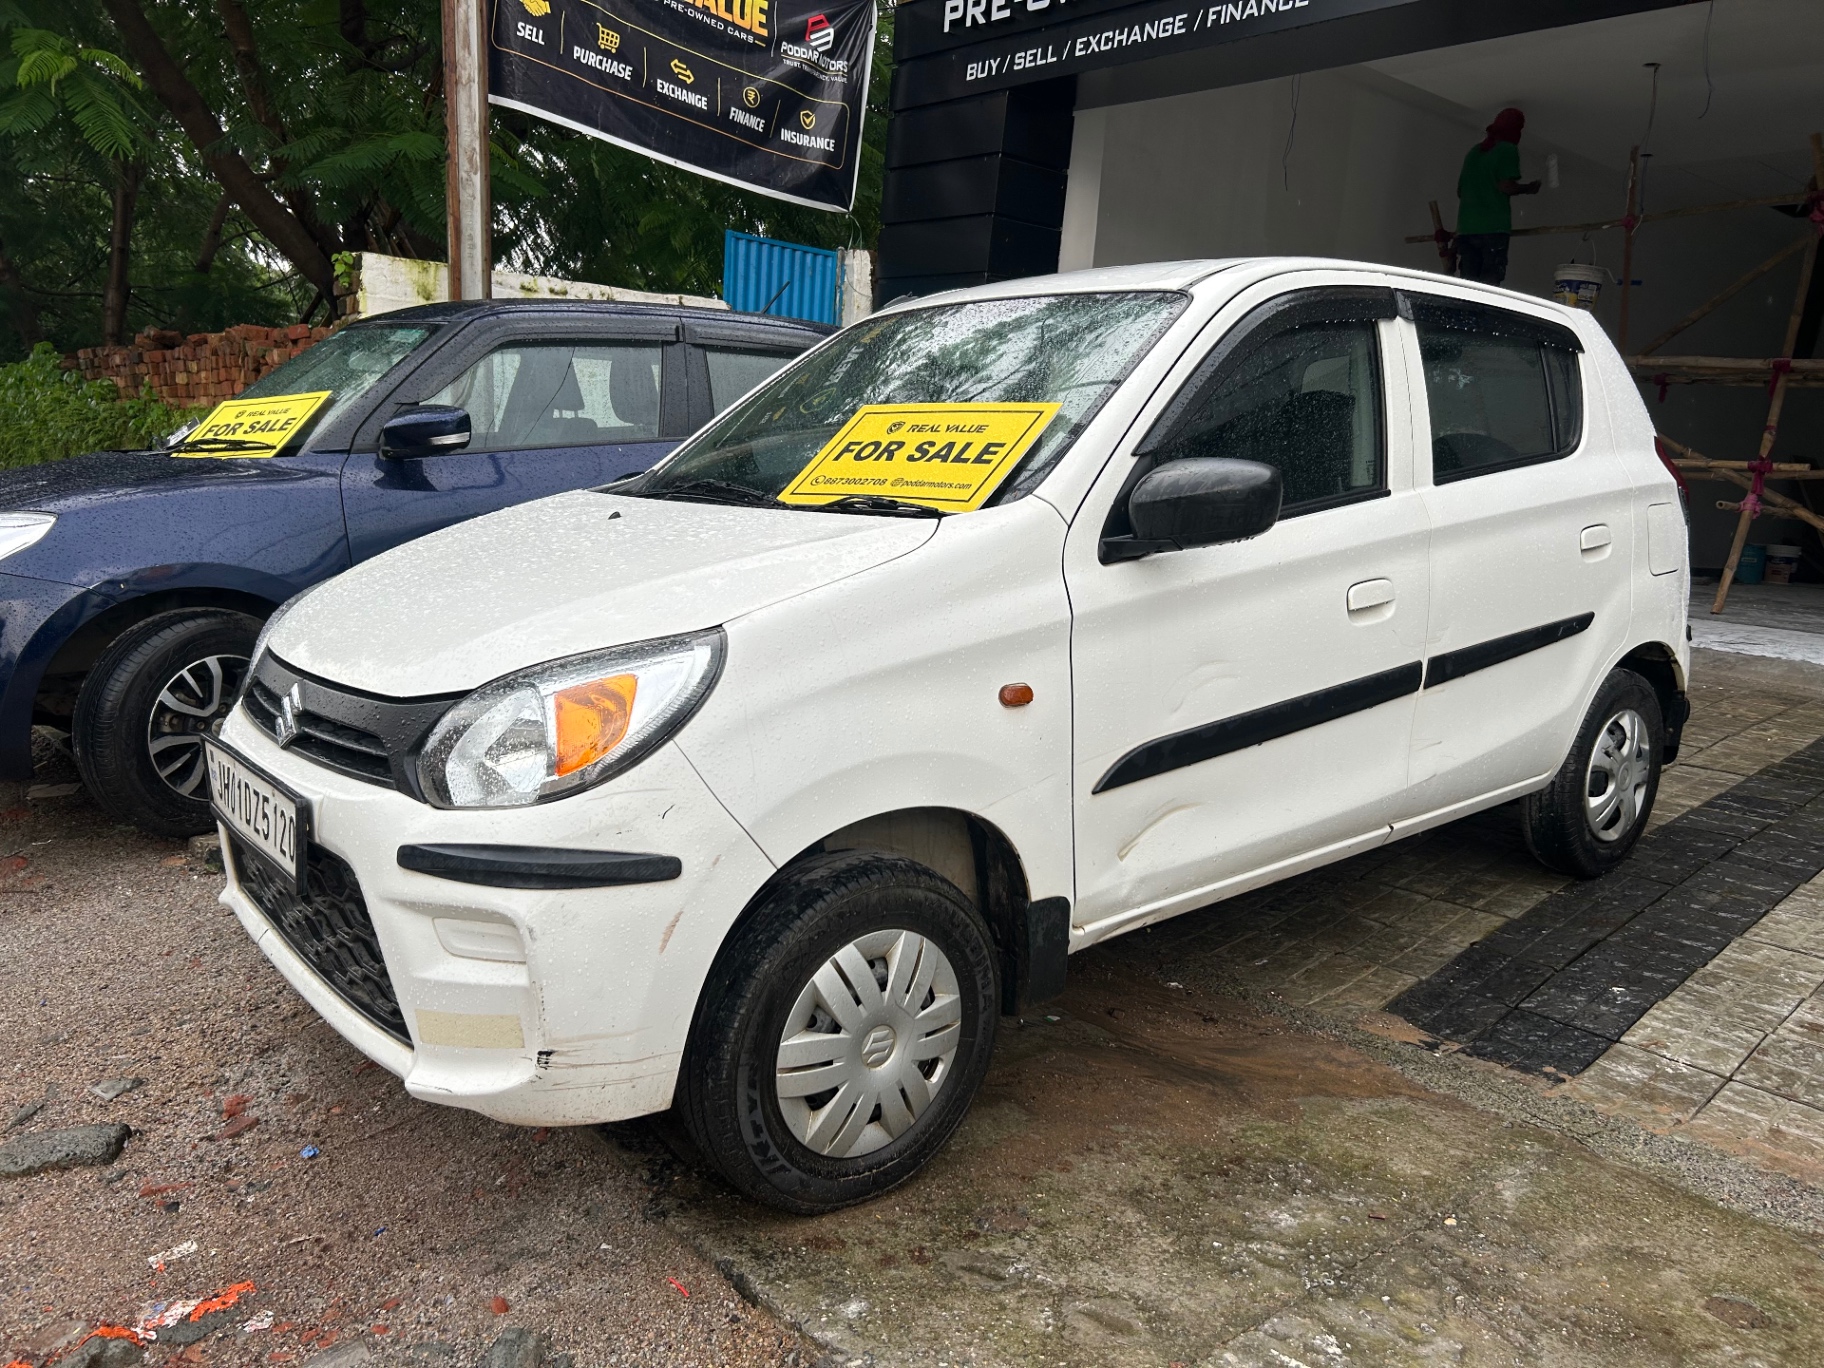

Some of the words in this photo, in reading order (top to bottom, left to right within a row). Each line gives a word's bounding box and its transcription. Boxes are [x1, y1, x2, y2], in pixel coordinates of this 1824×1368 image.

[663, 0, 725, 30] PRE-OWNED
[727, 26, 754, 44] CARS
[683, 0, 769, 37] LUE
[943, 0, 1066, 33] PRE-
[516, 22, 545, 45] SELL
[780, 41, 819, 63] PODDAR
[966, 57, 1001, 81] BUY
[1013, 45, 1057, 71] SELL
[1074, 13, 1189, 57] EXCHANGE
[573, 45, 633, 81] PURCHASE
[656, 79, 708, 111] EXCHANGE
[729, 107, 765, 133] FINANCE
[780, 127, 835, 152] INSURANCE
[200, 422, 245, 438] FOR
[243, 417, 298, 434] SALE
[907, 424, 942, 434] REAL
[945, 424, 989, 434] VALUE
[832, 440, 906, 462] FOR
[906, 440, 1007, 465] SALE
[824, 477, 888, 486] 8873002708
[217, 760, 296, 863] JH01DZ5120
